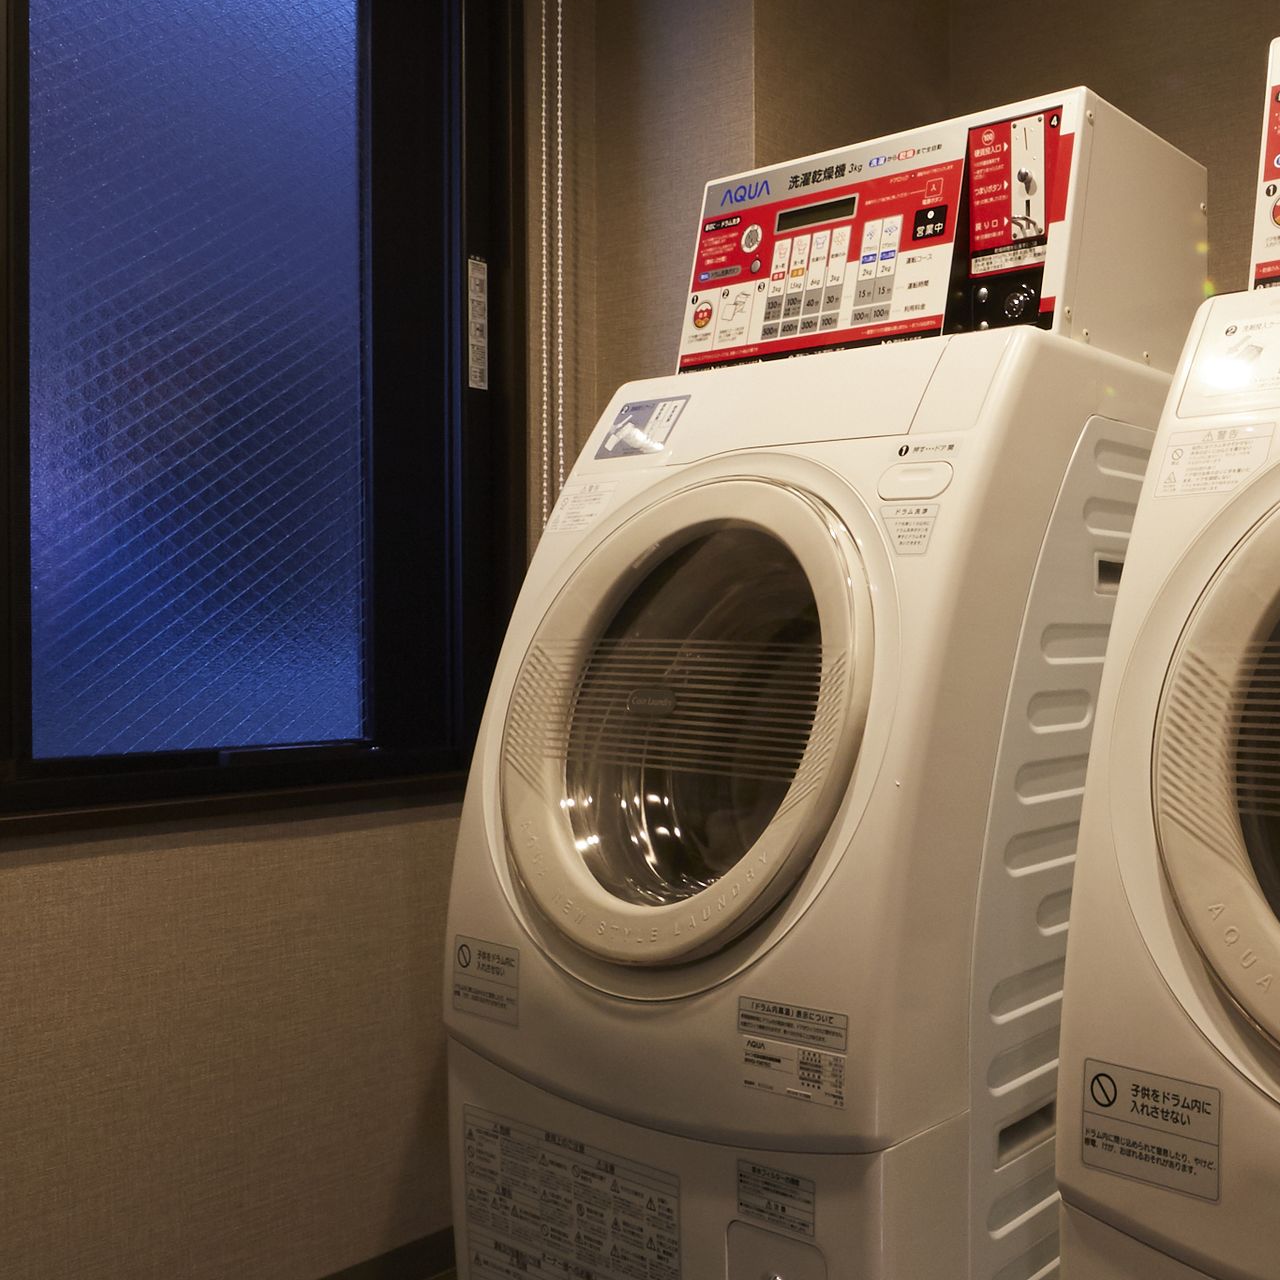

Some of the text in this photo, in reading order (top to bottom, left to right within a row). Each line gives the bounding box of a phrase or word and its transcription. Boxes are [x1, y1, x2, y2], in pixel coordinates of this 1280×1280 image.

[788, 161, 863, 191] 洗濯乾燥機 3kg
[720, 179, 770, 207] AQUA
[915, 222, 944, 238] 営業中
[746, 1040, 766, 1050] AQUA
[1130, 1083, 1212, 1115] 子供をドラム内に
[1130, 1100, 1191, 1126] 入れさせない
